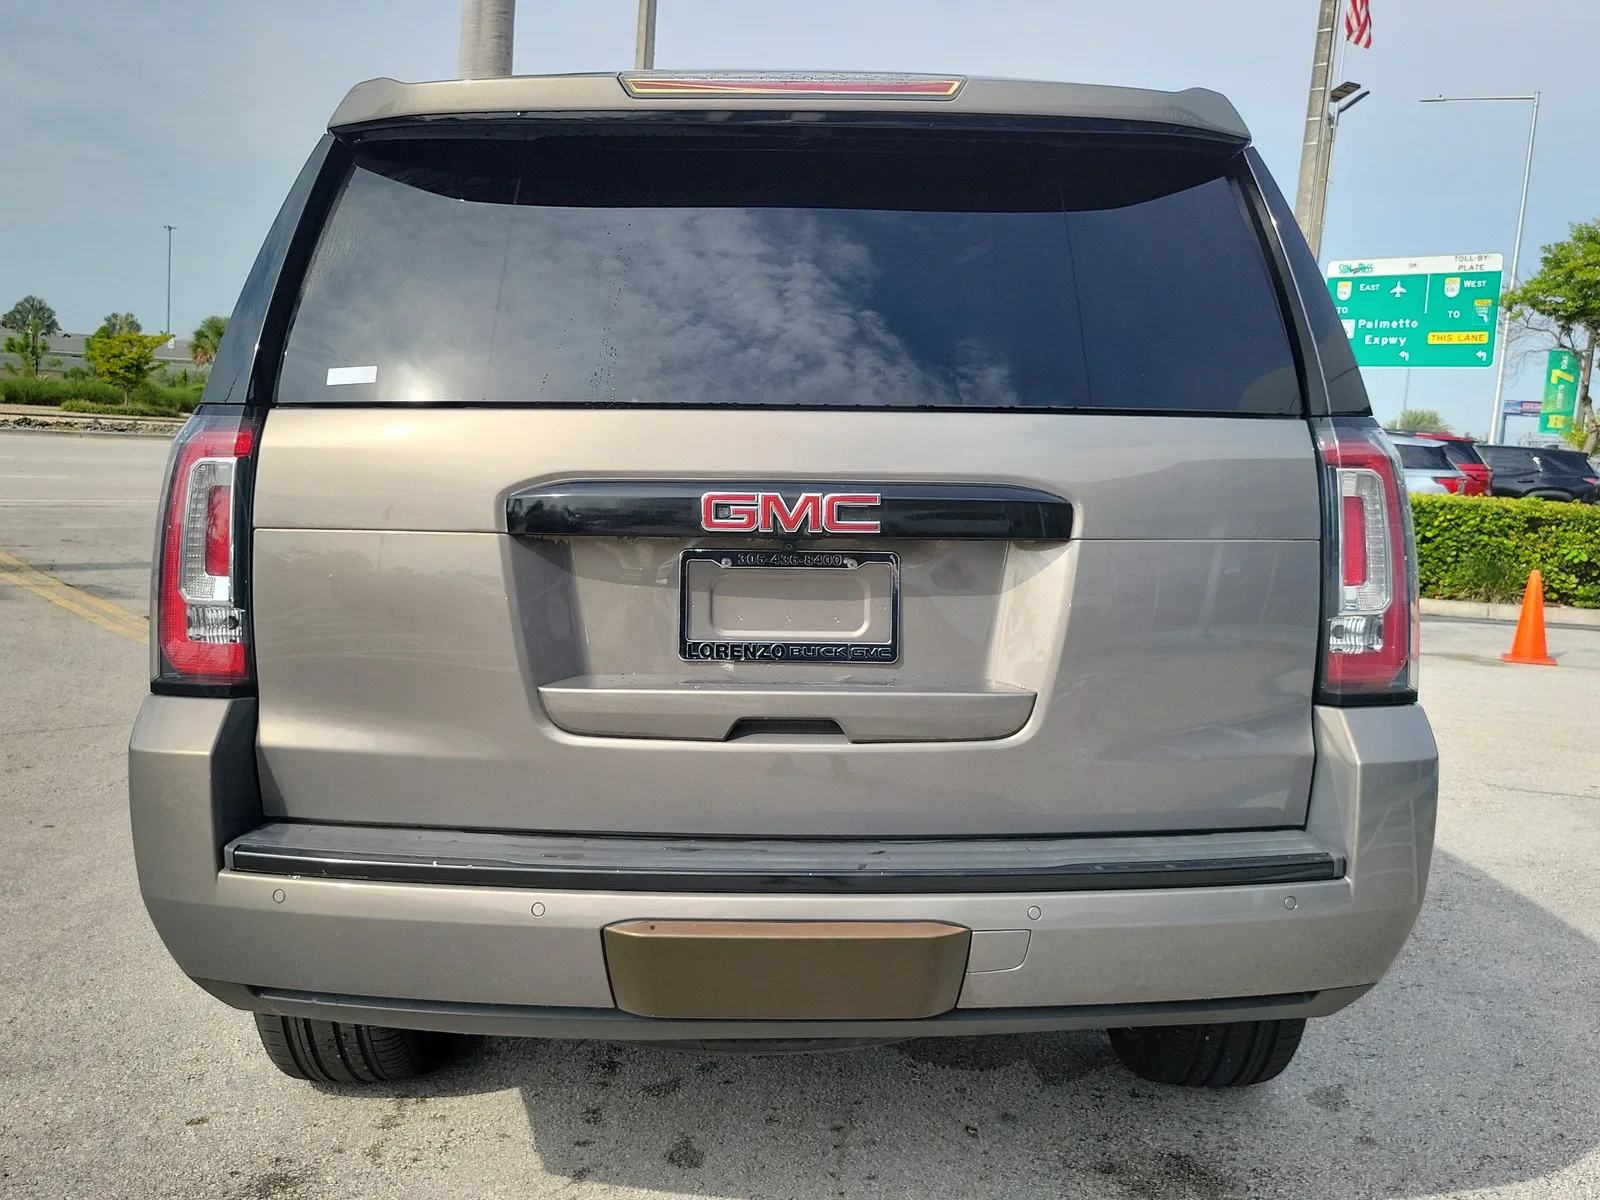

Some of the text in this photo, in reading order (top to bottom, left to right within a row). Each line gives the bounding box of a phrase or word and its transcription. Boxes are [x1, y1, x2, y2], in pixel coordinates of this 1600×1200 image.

[1359, 284, 1381, 292] EAST
[1463, 280, 1487, 288] WEST
[1336, 306, 1349, 315] TO
[1447, 310, 1461, 319] TO
[1358, 318, 1419, 329] Palmetto
[1364, 334, 1407, 347] Expwy
[1431, 333, 1485, 342] THIS LANE
[701, 491, 882, 533] GMC
[737, 553, 843, 566] 305-436-8400
[686, 643, 893, 660] LORENZO BUICK GMC
